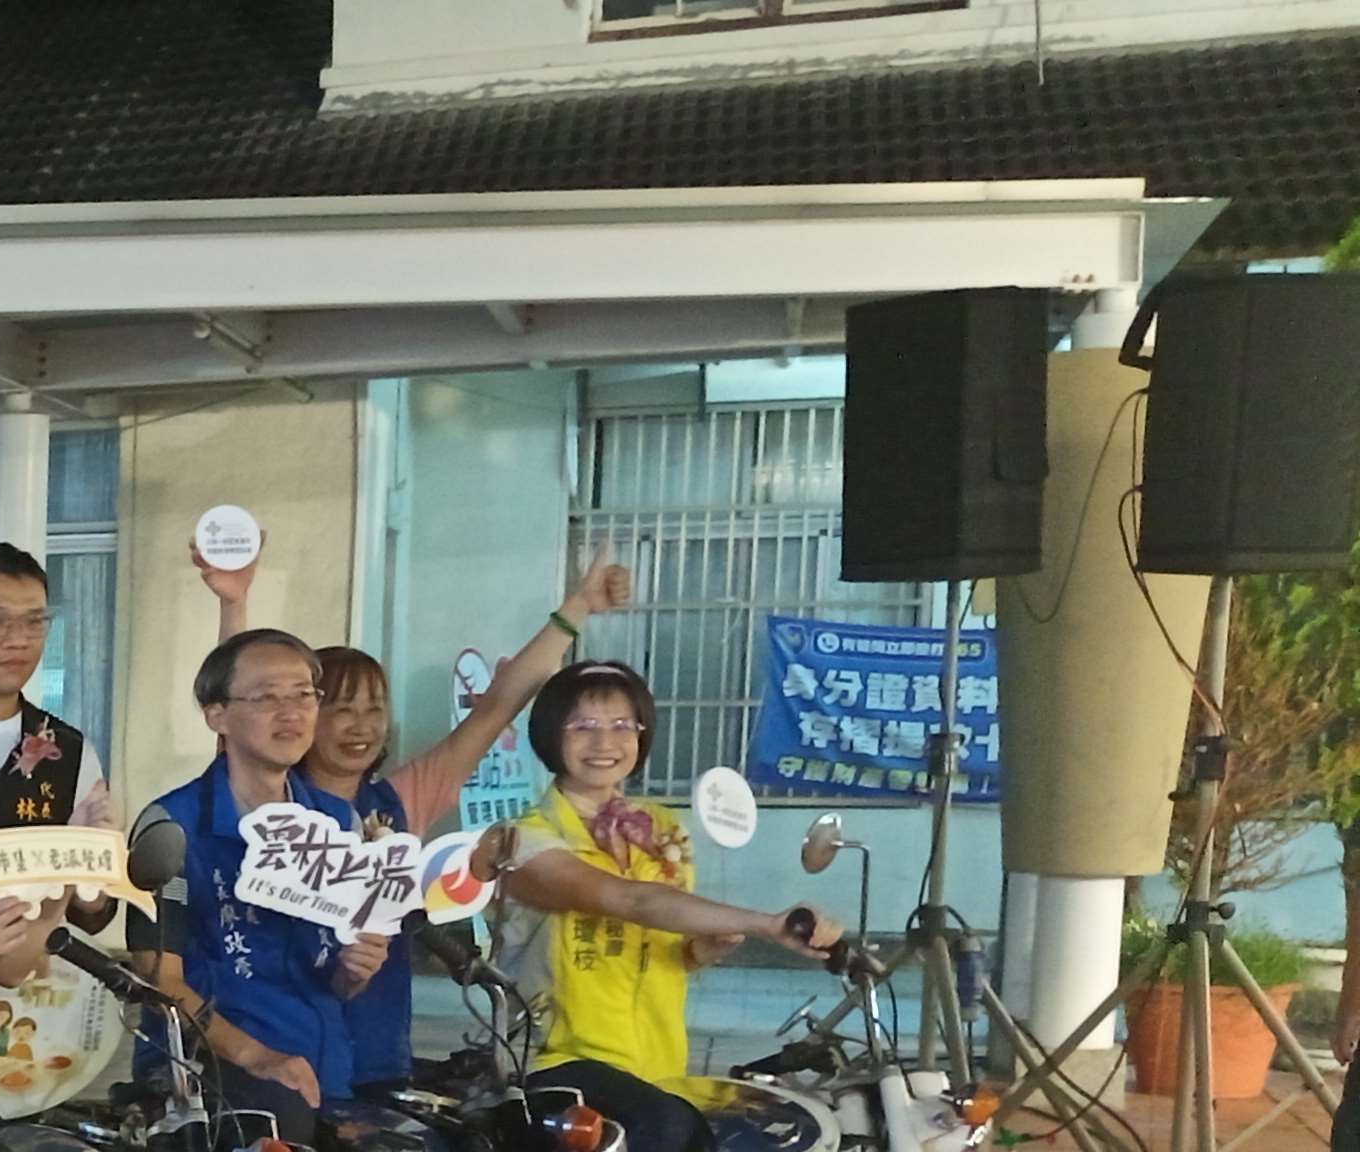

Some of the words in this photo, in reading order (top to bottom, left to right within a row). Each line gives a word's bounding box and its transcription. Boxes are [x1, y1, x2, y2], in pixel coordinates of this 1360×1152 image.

[782, 663, 998, 715] 身分證資料
[15, 796, 40, 823] 林
[251, 813, 417, 931] 雲林上場
[247, 876, 276, 897] It's
[278, 889, 308, 907] Our
[309, 894, 351, 918] Time
